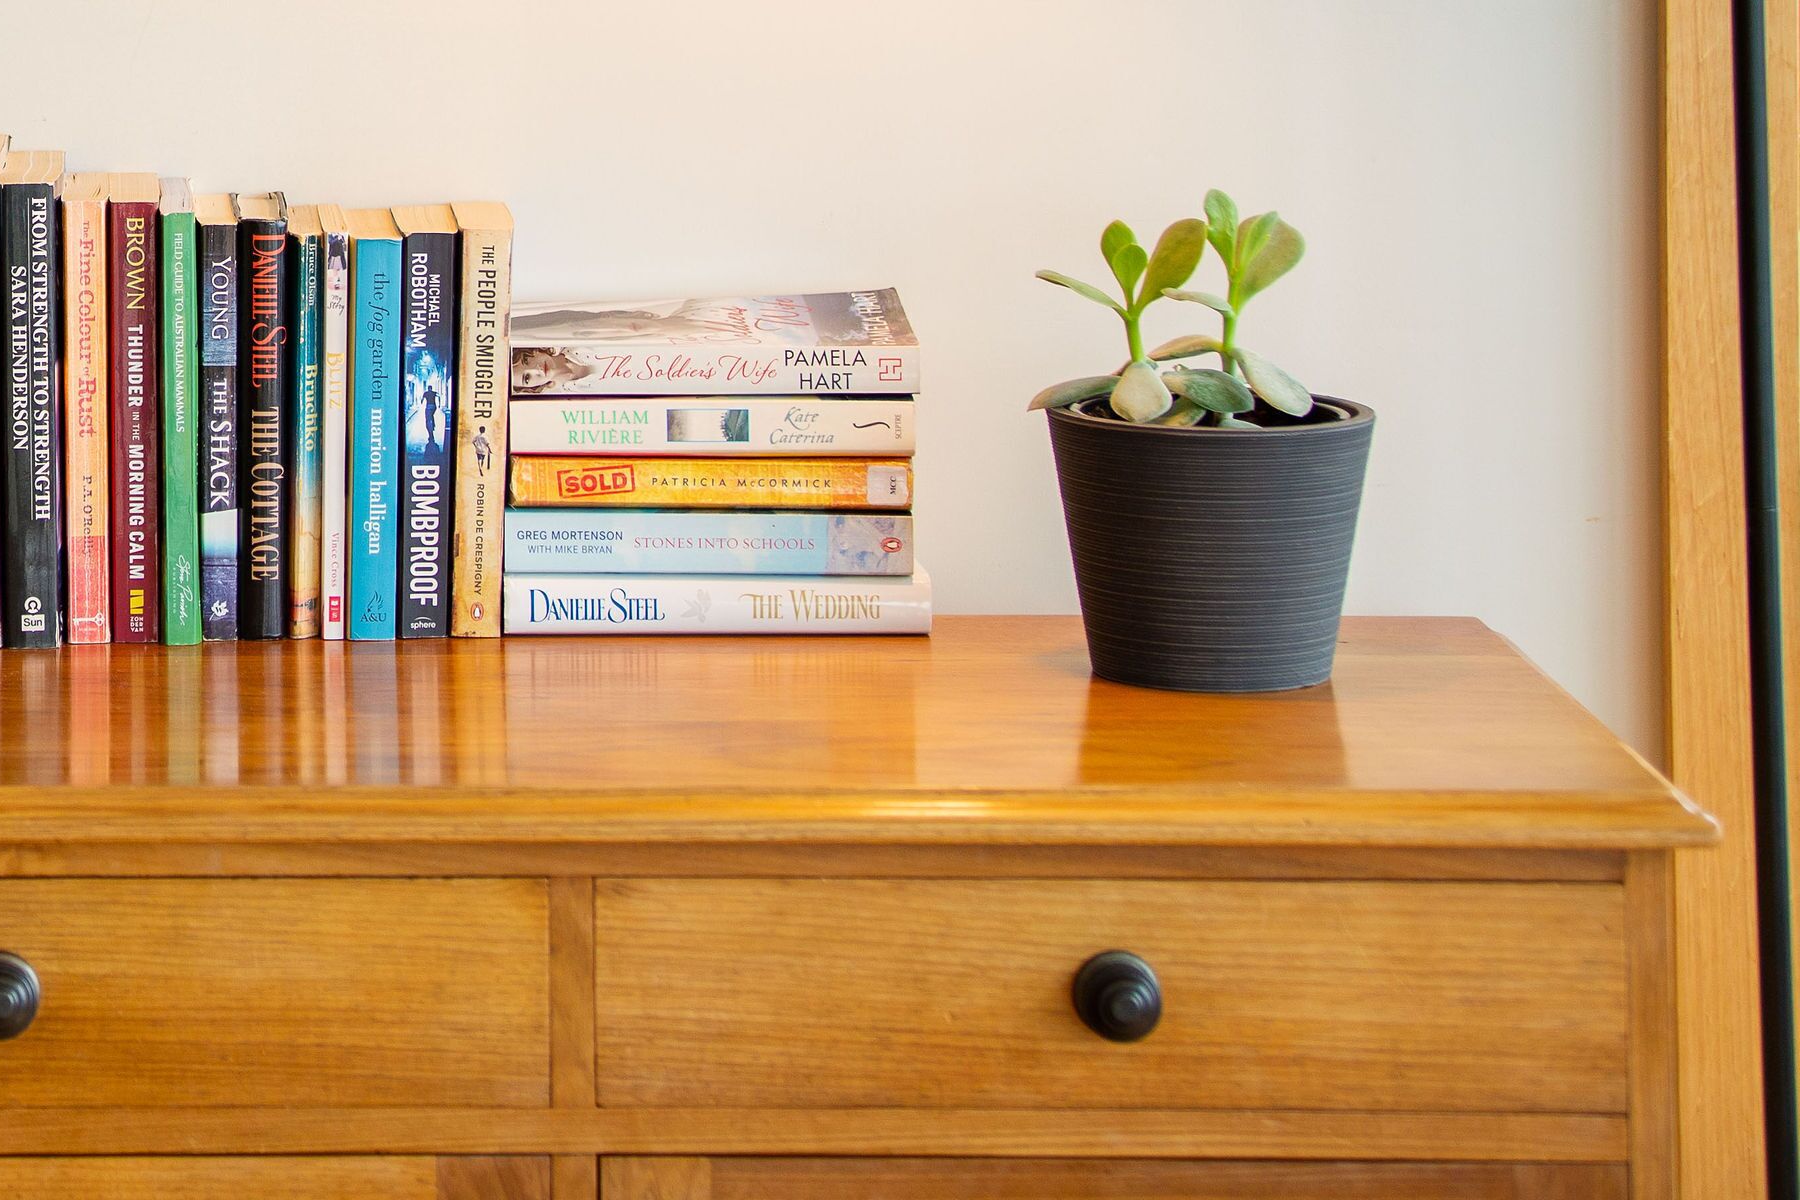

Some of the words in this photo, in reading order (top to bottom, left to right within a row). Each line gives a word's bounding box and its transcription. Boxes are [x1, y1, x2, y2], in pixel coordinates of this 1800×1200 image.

[31, 197, 48, 257] FROM
[82, 221, 90, 238] The
[79, 240, 94, 286] Fine
[126, 217, 145, 311] BROWN
[174, 233, 184, 260] FIELD
[307, 243, 316, 273] Bruce
[481, 245, 495, 265] THE
[11, 265, 27, 323] SARA
[174, 262, 184, 294] GUIDE
[252, 233, 286, 320] DANIELLE
[307, 275, 315, 306] Olson
[374, 272, 390, 300] the
[174, 299, 184, 312] TO
[211, 256, 231, 341] YOUNG
[411, 253, 427, 348] ROBOTHAM
[427, 274, 440, 327] MICHAEL
[477, 270, 496, 329] PEOPLE
[32, 262, 49, 373] STRENGTH
[78, 290, 96, 361] Colour
[367, 301, 390, 334] fog
[174, 315, 185, 374] AUSTRALIAN
[252, 322, 286, 387] STEEL
[784, 349, 866, 367] PAMELA
[127, 325, 143, 408] THUNDER
[327, 352, 345, 409] BLITZ
[367, 339, 388, 400] garden
[474, 335, 494, 419] SMUGGLER
[596, 353, 631, 379] The
[637, 356, 715, 384] Soldier's
[718, 356, 777, 384] Wife
[800, 373, 852, 390] HART
[12, 325, 29, 450] HENDERSON
[33, 375, 50, 405] TO
[213, 378, 227, 414] THE
[78, 377, 97, 439] Rust
[132, 412, 141, 420] IN
[175, 381, 185, 433] MAMMALS
[304, 364, 317, 452] Bruchko
[562, 410, 649, 425] WILLIAM
[784, 407, 819, 429] Kate
[132, 424, 140, 441] THE
[251, 407, 279, 458] THE
[370, 409, 385, 474] marion
[568, 427, 643, 444] RIVIÈRE
[769, 429, 834, 445] Caterina
[34, 409, 52, 520] STRENGTH
[210, 420, 231, 508] SHACK
[128, 445, 144, 525] MORNING
[565, 472, 627, 494] SOLD
[652, 477, 726, 487] PATRICIA
[737, 478, 831, 488] McCORMICK
[251, 462, 286, 582] COTTAGE
[363, 481, 387, 554] halligan
[476, 520, 484, 533] DE
[517, 530, 547, 541] GREG
[551, 530, 622, 541] MORTENSON
[331, 532, 339, 558] Vince
[410, 465, 439, 607] BOMBPROOF
[528, 545, 552, 554] WITH
[555, 545, 579, 554] MIKE
[582, 545, 612, 554] BRYAN
[634, 537, 695, 549] STONES
[699, 538, 739, 549] INTO
[743, 538, 814, 549] SCHOOLS
[129, 530, 144, 580] CALM
[475, 536, 484, 595] CRESPIGNY
[331, 561, 339, 588] Cross
[24, 617, 42, 626] Sun
[359, 612, 386, 623] A&U
[529, 589, 607, 623] DANIELLE
[607, 587, 665, 623] STEEL
[739, 593, 783, 619] THE
[788, 589, 880, 620] WEDDING
[410, 619, 436, 629] sphere
